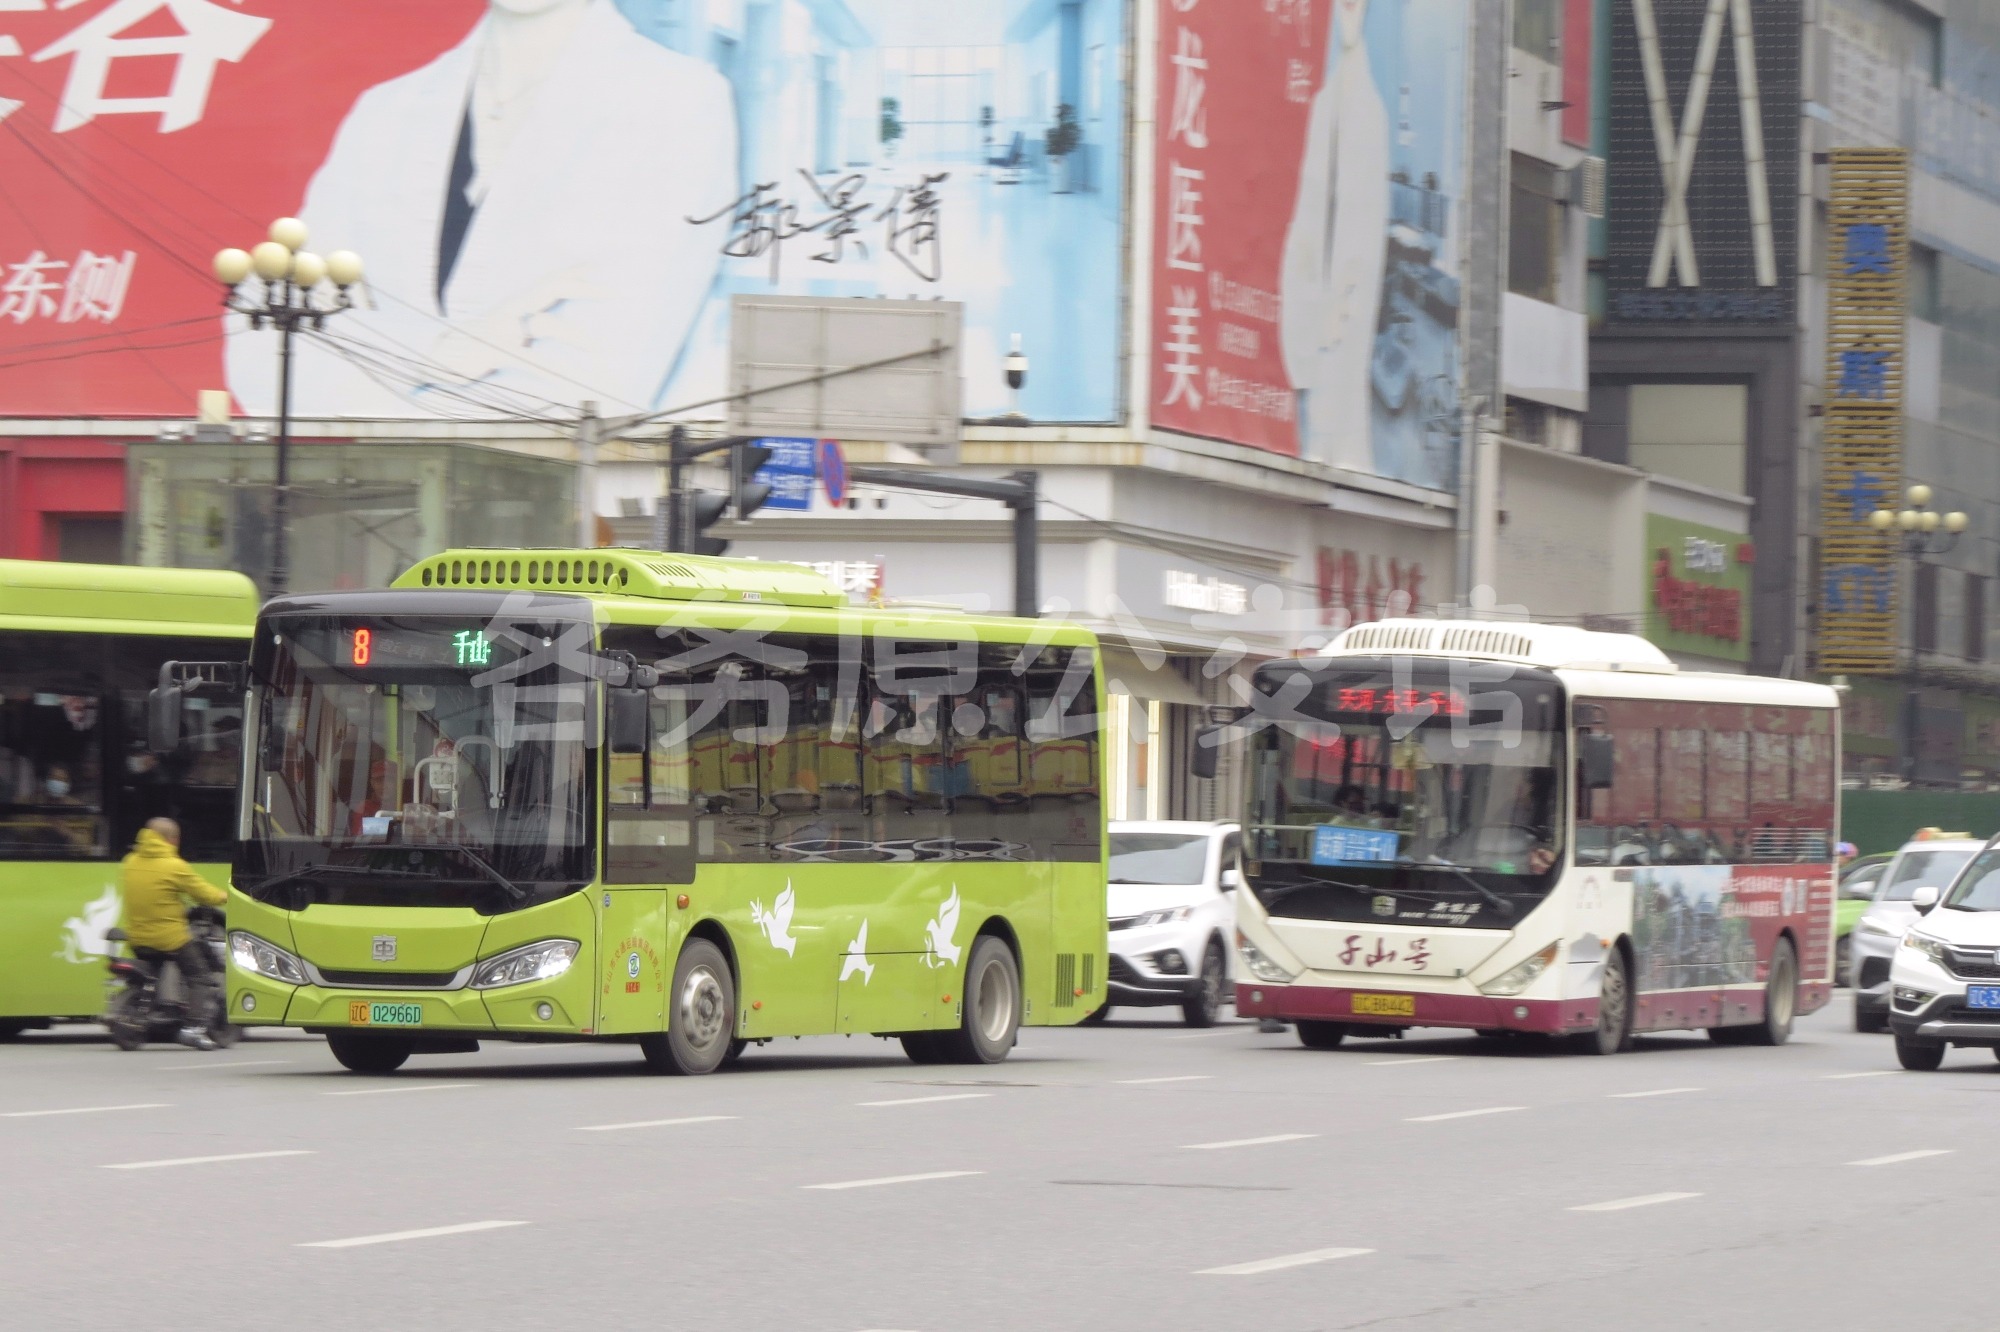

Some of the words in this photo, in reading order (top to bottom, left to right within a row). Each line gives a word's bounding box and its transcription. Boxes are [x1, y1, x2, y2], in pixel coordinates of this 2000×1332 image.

[1161, 0, 1208, 411] 龙医美
[0, 249, 138, 324] 东侧
[353, 628, 370, 665] 8
[1336, 934, 1433, 971] 千山号
